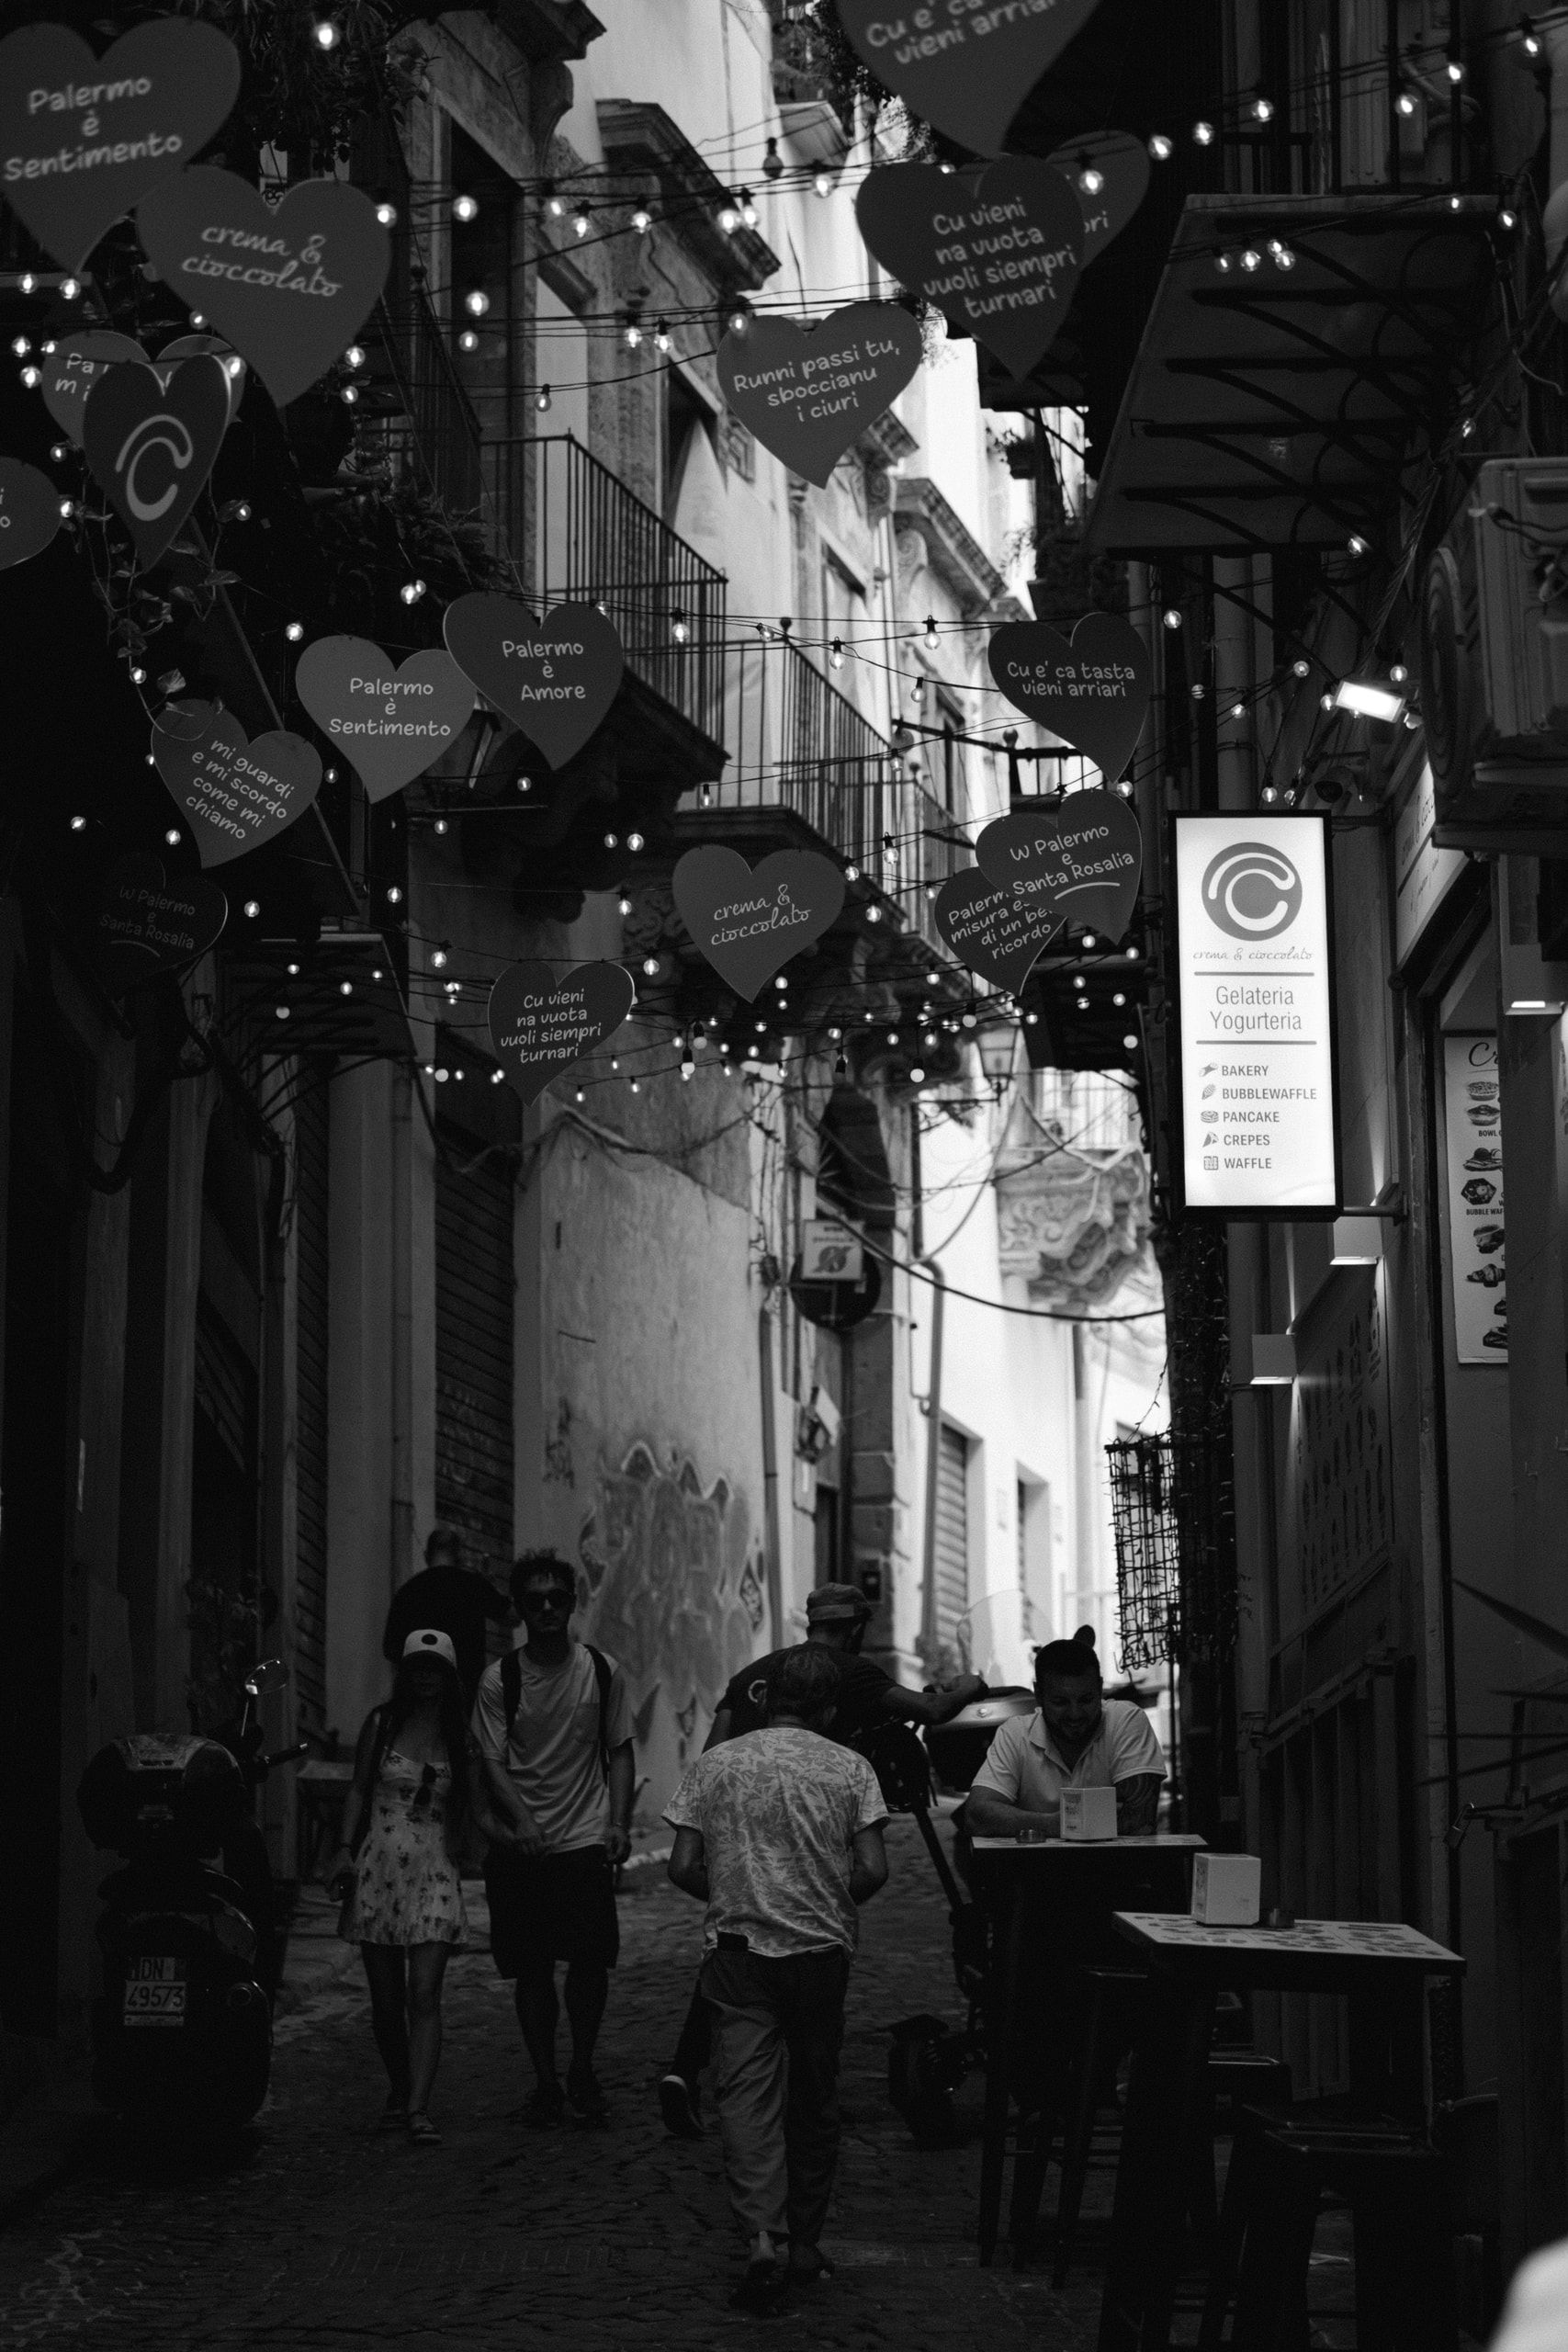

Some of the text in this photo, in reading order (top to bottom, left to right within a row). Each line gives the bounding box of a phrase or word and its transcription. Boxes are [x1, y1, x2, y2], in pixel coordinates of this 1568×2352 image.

[867, 19, 907, 47] Cu
[894, 0, 1055, 64] vieni arria
[28, 77, 152, 115] Palermo
[3, 132, 183, 181] Sentimento
[933, 196, 1027, 235] Cu vieni
[200, 227, 291, 257] crema
[935, 226, 1044, 265] na vuota
[181, 254, 344, 297] cioccolato
[923, 244, 1077, 296] vuoli siempri
[964, 278, 1056, 318] turnari
[733, 340, 900, 392] Runni passi tu,
[767, 368, 878, 406] sboccianu
[796, 390, 859, 423] i ciuri
[502, 639, 584, 658] Palermo
[542, 659, 554, 678] è
[1007, 662, 1031, 677] Cu
[1055, 665, 1076, 679] ca
[1081, 662, 1135, 680] tasta
[350, 677, 434, 695] Palermo
[521, 684, 586, 701] Amore
[1022, 679, 1126, 696] vieni arriari
[385, 697, 396, 715] è
[329, 718, 451, 736] Sentimento
[210, 740, 295, 799] mi guardi
[192, 752, 287, 819] e mi scordo
[193, 777, 265, 828] come mi
[186, 797, 245, 839] chiamo
[1010, 826, 1110, 861] W Palermo
[1062, 853, 1073, 865] e
[1012, 853, 1134, 895] Santa Rosalia
[137, 889, 196, 916] Palermo
[714, 897, 772, 921] crema
[948, 890, 1010, 925] Palerm
[147, 911, 157, 923] e
[711, 903, 812, 945] cioccolato
[951, 908, 1009, 944] misura
[981, 907, 1053, 945] di un be
[99, 913, 195, 949] Santa Rosalia
[992, 924, 1052, 959] ricordo
[1192, 950, 1228, 960] crema
[1249, 945, 1314, 960] cioccolato
[524, 988, 584, 1009] Cu vieni
[1215, 986, 1294, 1005] Gelateria
[516, 1007, 588, 1027] na vuota
[1210, 1011, 1303, 1034] Yogurteria
[501, 1022, 602, 1046] vuoli siempri
[520, 1042, 580, 1064] turnari
[1222, 1065, 1269, 1076] BAKERY
[1222, 1088, 1317, 1100] BUBBLEWAFFLE
[1223, 1111, 1280, 1123] PANCAKE
[1224, 1135, 1270, 1146] CREPES
[1224, 1158, 1272, 1169] WAFFLE
[127, 1985, 184, 2007] 49573
